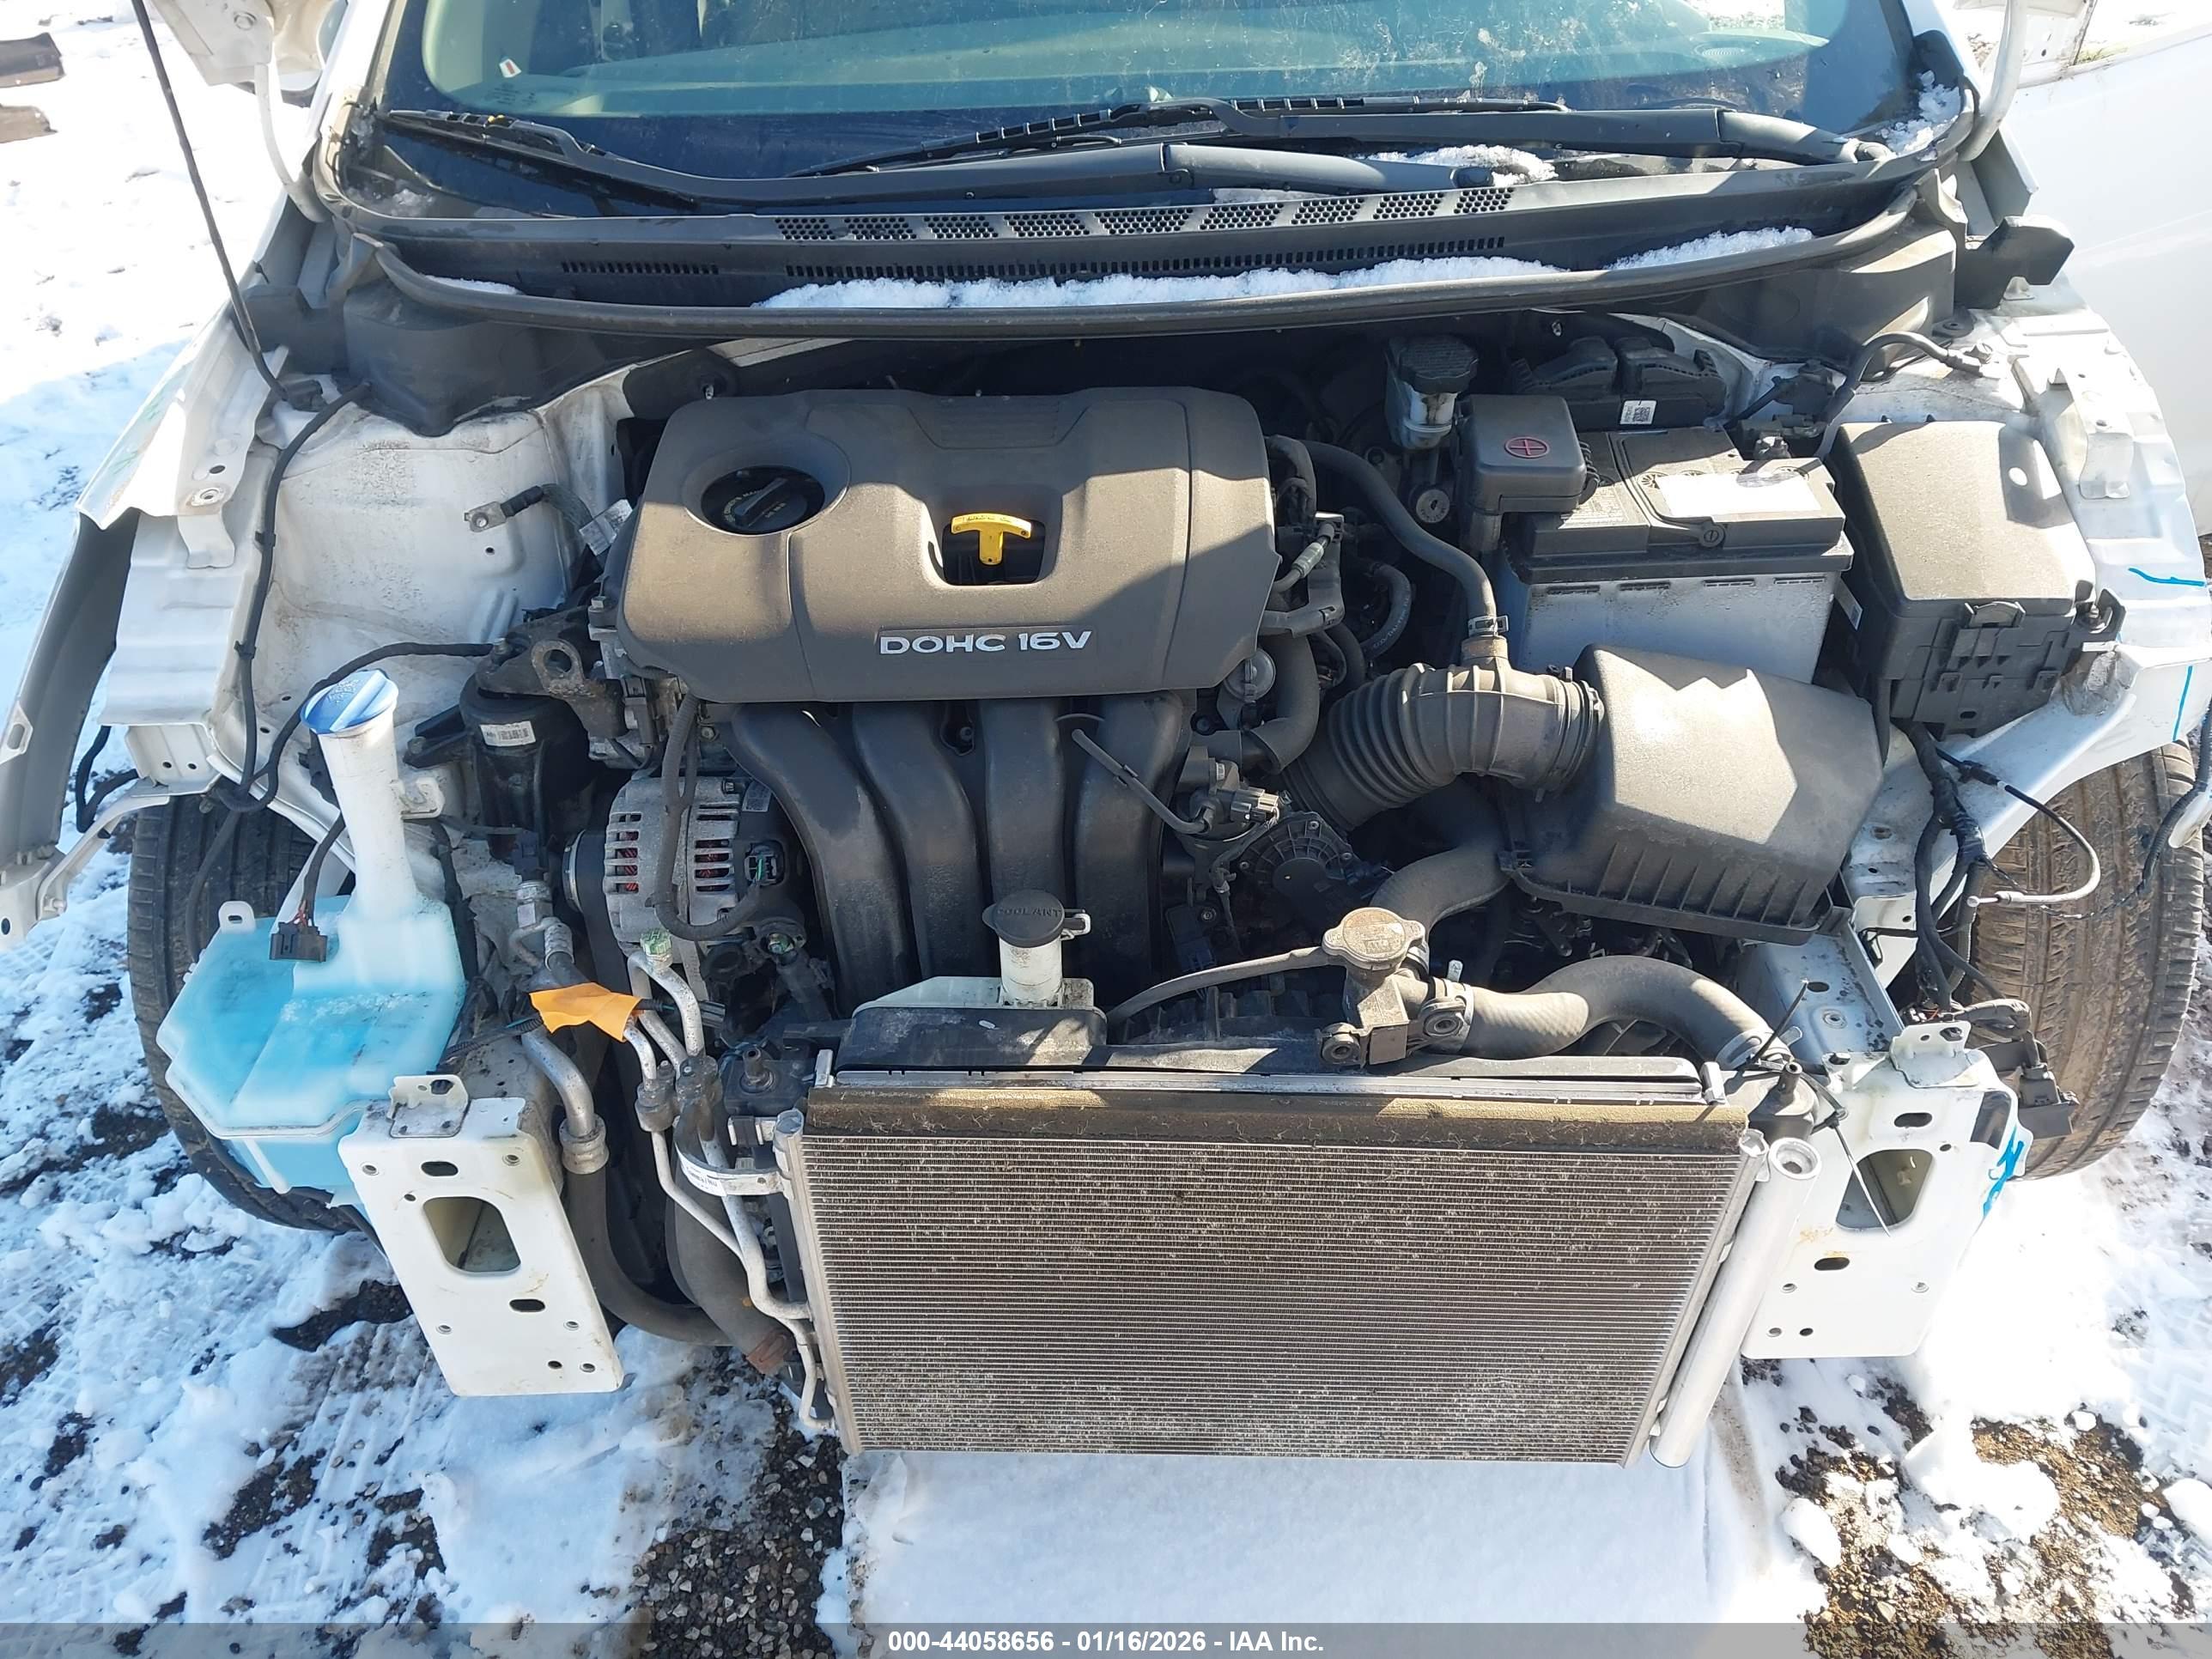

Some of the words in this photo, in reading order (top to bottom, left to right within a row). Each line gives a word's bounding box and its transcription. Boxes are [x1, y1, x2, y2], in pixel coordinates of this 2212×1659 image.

[880, 634, 1006, 654] DOHC
[1018, 631, 1092, 651] 16V
[997, 907, 1063, 917] COOLANT
